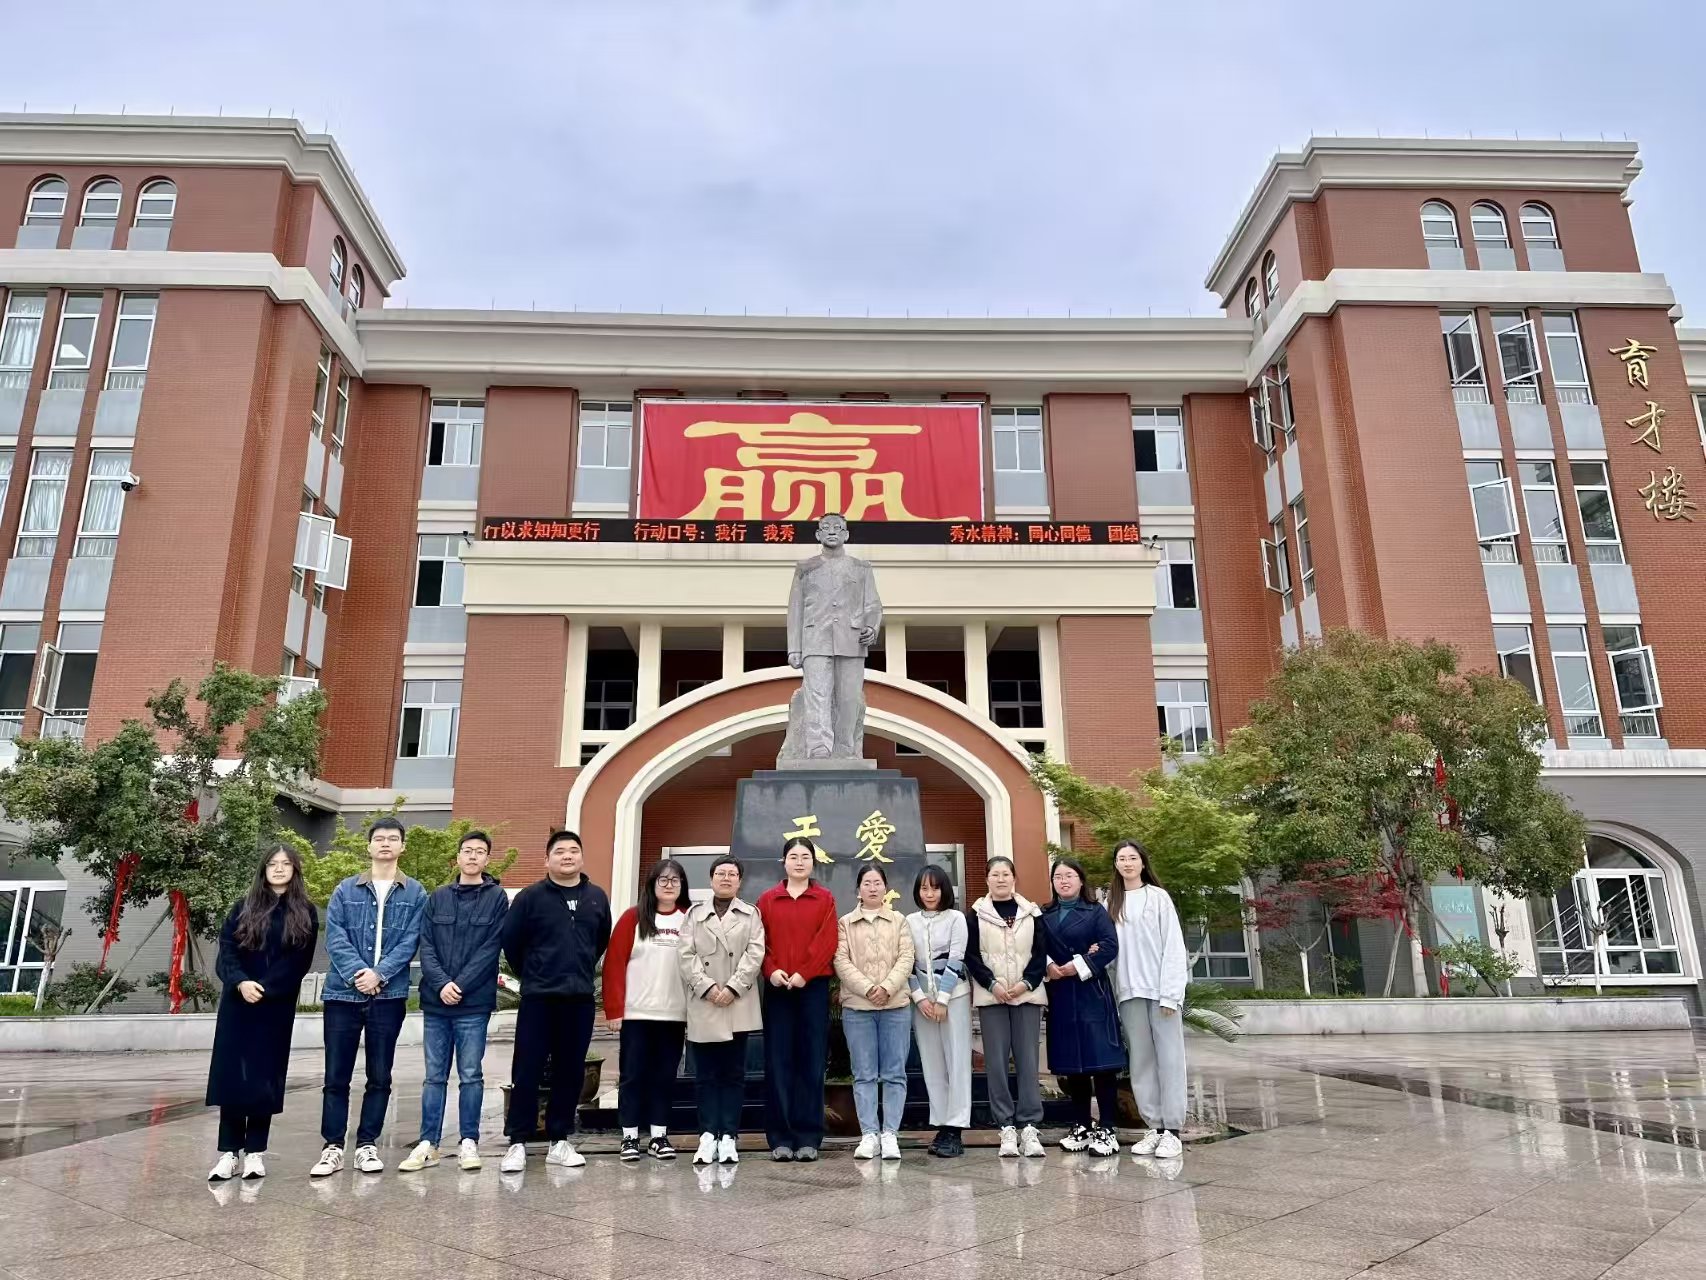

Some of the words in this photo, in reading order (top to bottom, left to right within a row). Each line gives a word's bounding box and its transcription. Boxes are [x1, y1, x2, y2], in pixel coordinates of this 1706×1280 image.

[678, 412, 972, 521] 赢
[1608, 338, 1699, 522] 育才楼
[762, 523, 796, 542] 我秀
